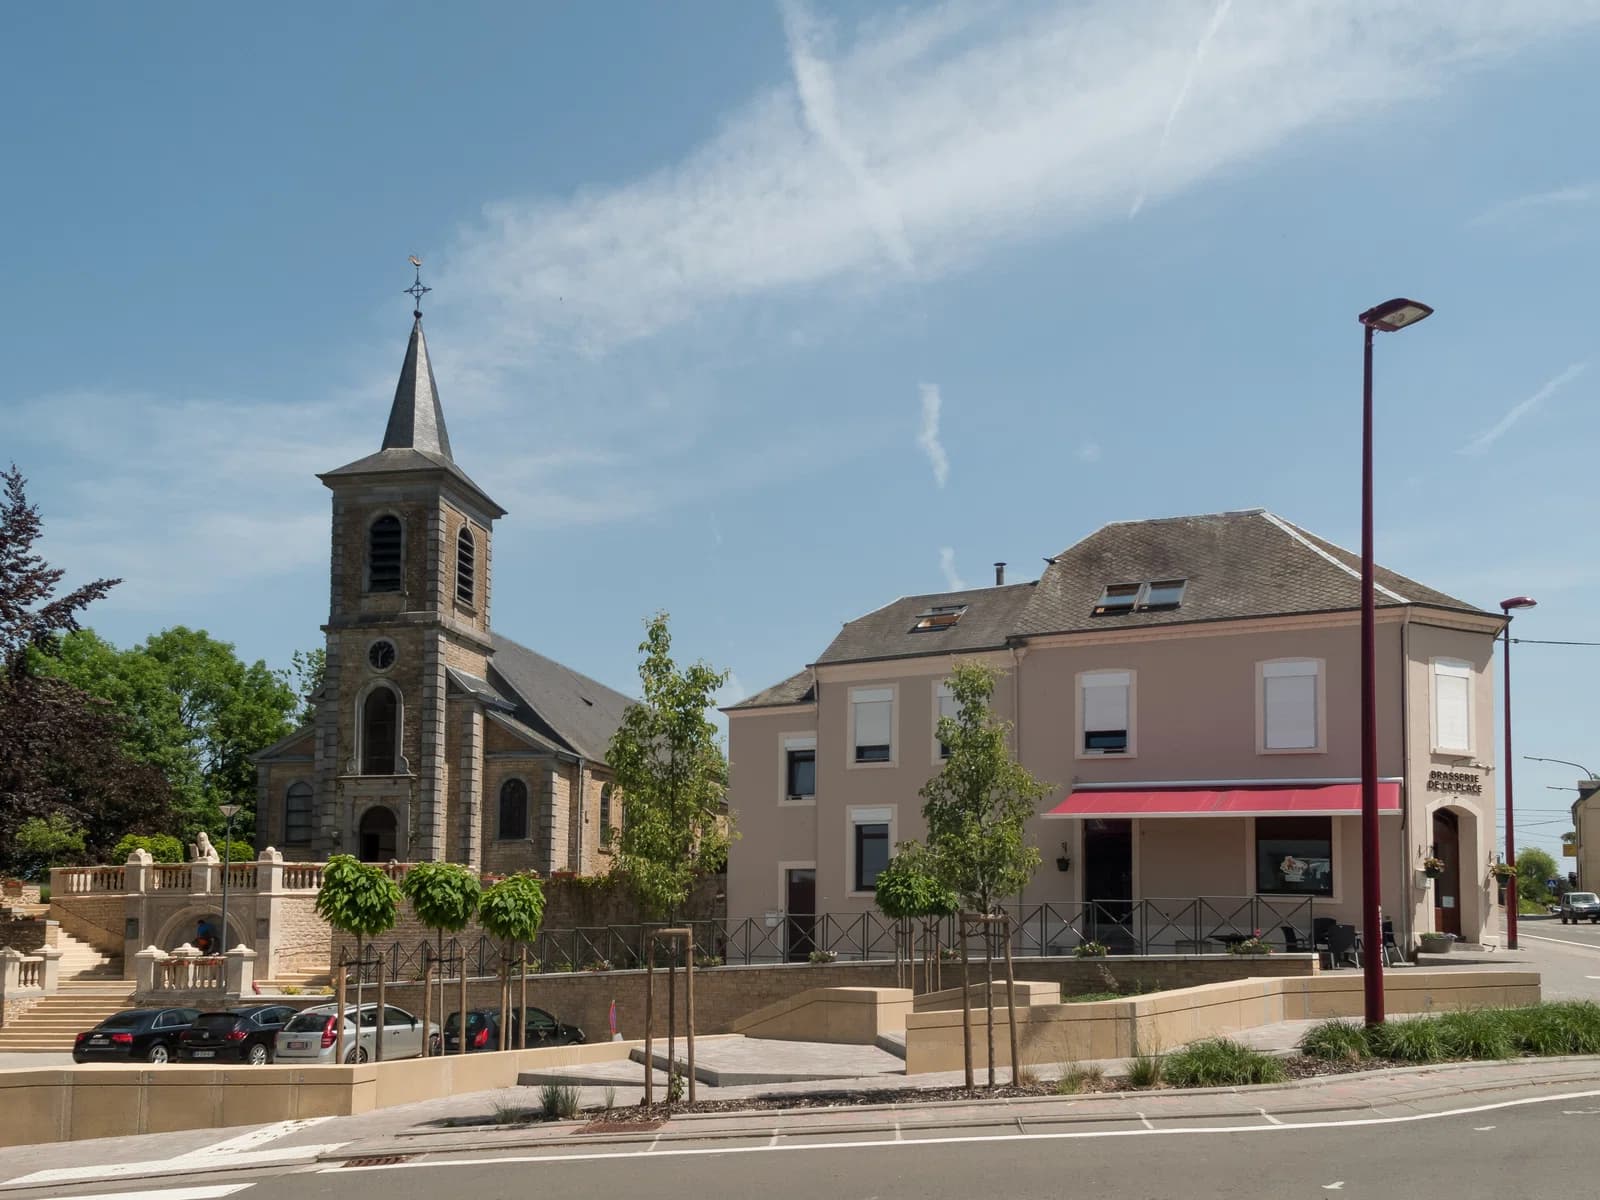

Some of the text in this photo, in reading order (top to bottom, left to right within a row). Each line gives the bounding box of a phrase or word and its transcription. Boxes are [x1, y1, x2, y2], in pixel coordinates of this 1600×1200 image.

[1430, 770, 1480, 783] BRASSERIE
[1428, 780, 1483, 793] DE LA PLACE
